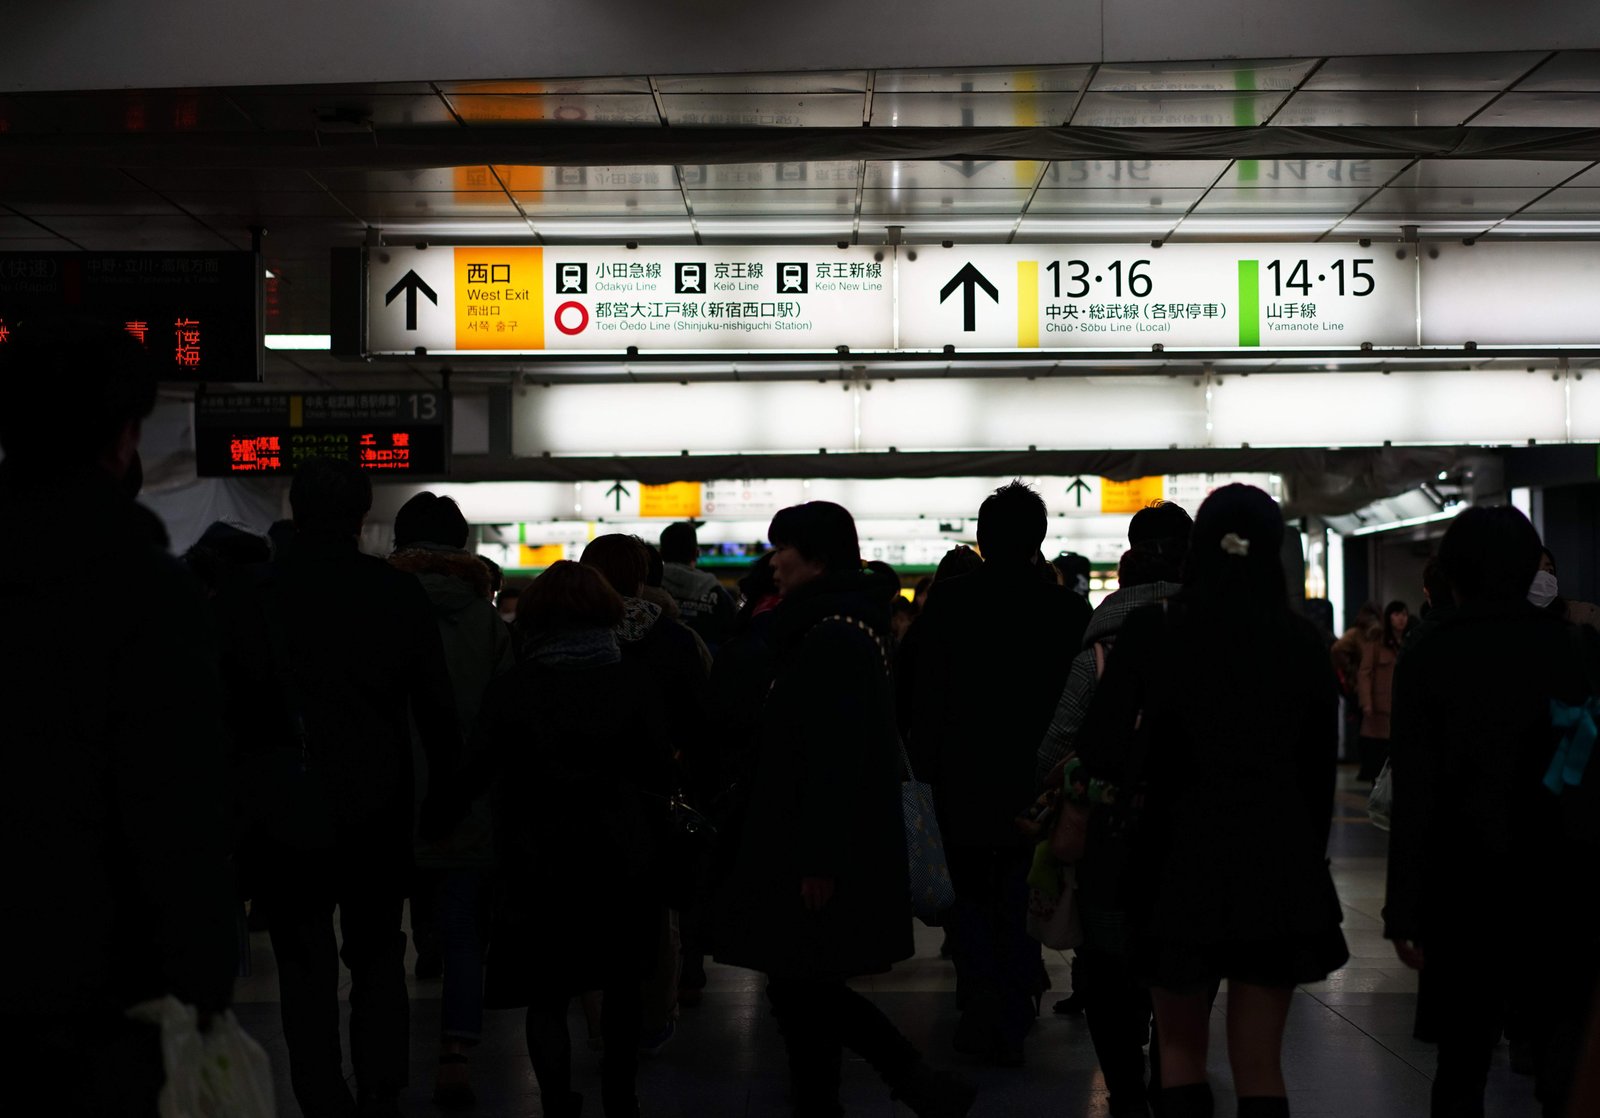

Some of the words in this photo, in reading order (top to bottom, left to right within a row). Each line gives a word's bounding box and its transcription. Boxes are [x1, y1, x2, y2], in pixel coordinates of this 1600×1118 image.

[467, 263, 511, 284] 西口
[595, 262, 662, 279] 小田急線
[713, 262, 764, 279] 京王線
[815, 262, 882, 279] 京王新線
[635, 280, 656, 291] Line
[738, 280, 759, 291] Line
[838, 280, 860, 291] New
[861, 280, 883, 291] Line
[467, 288, 501, 301] West
[505, 288, 529, 301] Exit
[467, 304, 501, 317] 西出口
[595, 301, 801, 319] 都営大江戸線（新宿西口駅）
[1266, 302, 1317, 319] 山手線
[467, 320, 490, 333] 서쪽
[495, 320, 519, 333] 출구
[595, 320, 617, 331] Toei
[650, 320, 672, 331] Line
[673, 320, 772, 333] (Shinjuku-nishiguchi
[774, 320, 813, 332] Station)
[1110, 321, 1132, 333] Line
[1134, 321, 1171, 333] (Local)
[1266, 321, 1319, 332] Yamanote
[1322, 321, 1345, 332] Line
[408, 393, 437, 420] 13
